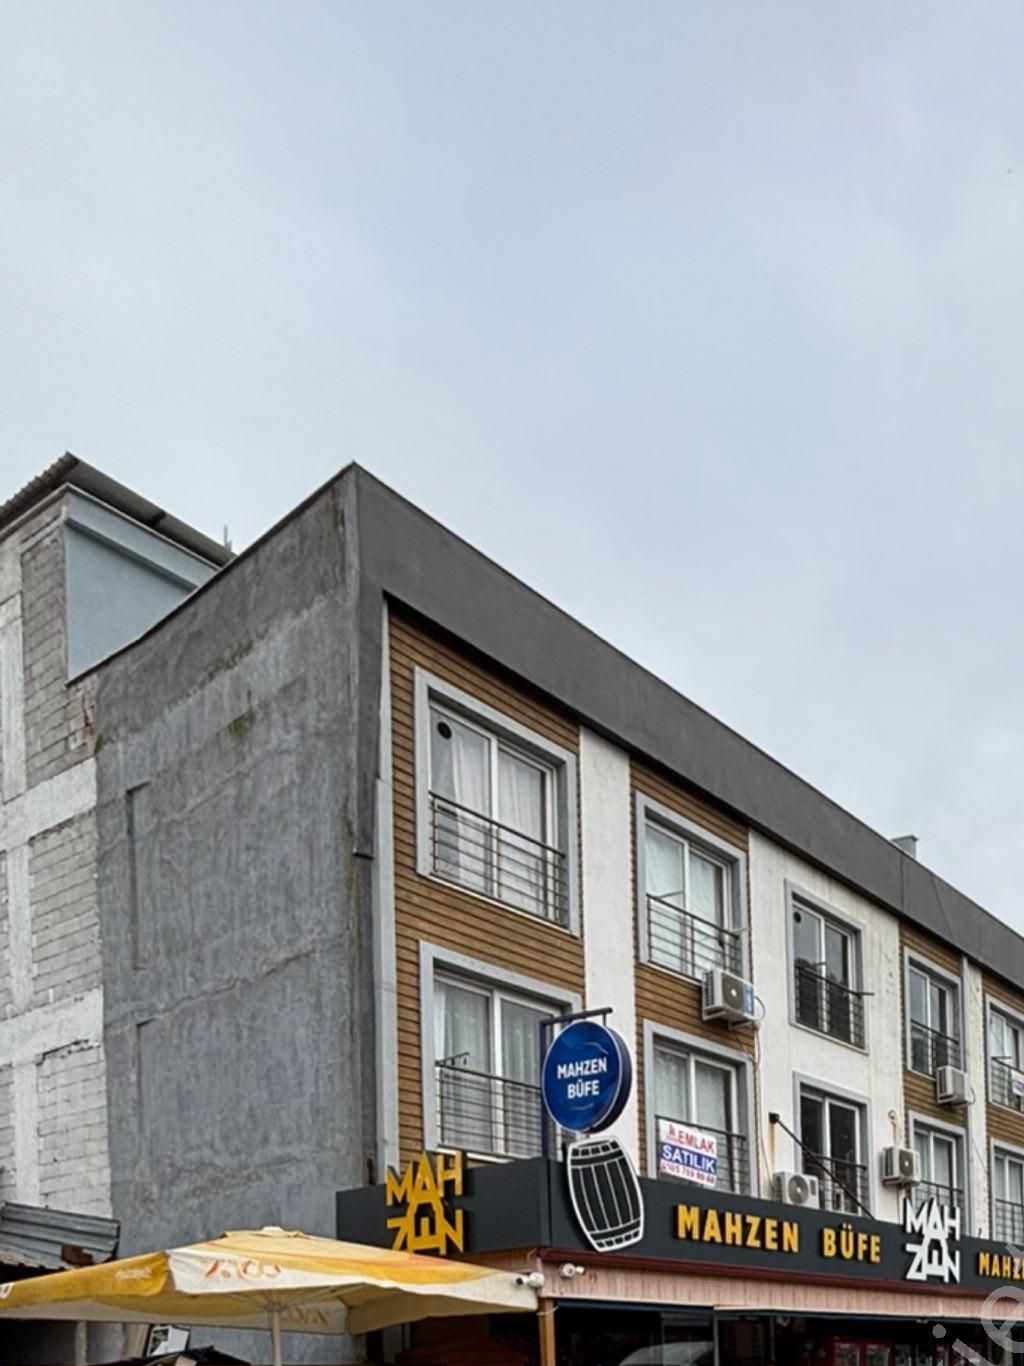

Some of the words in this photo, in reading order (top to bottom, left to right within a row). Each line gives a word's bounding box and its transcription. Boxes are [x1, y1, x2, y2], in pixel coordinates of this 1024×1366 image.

[556, 1057, 608, 1080] MAHZEN
[567, 1078, 600, 1100] BÜFE
[661, 1143, 716, 1174] SATILIK
[676, 1203, 799, 1254] MAHZEN
[821, 1222, 881, 1264] BÜFE
